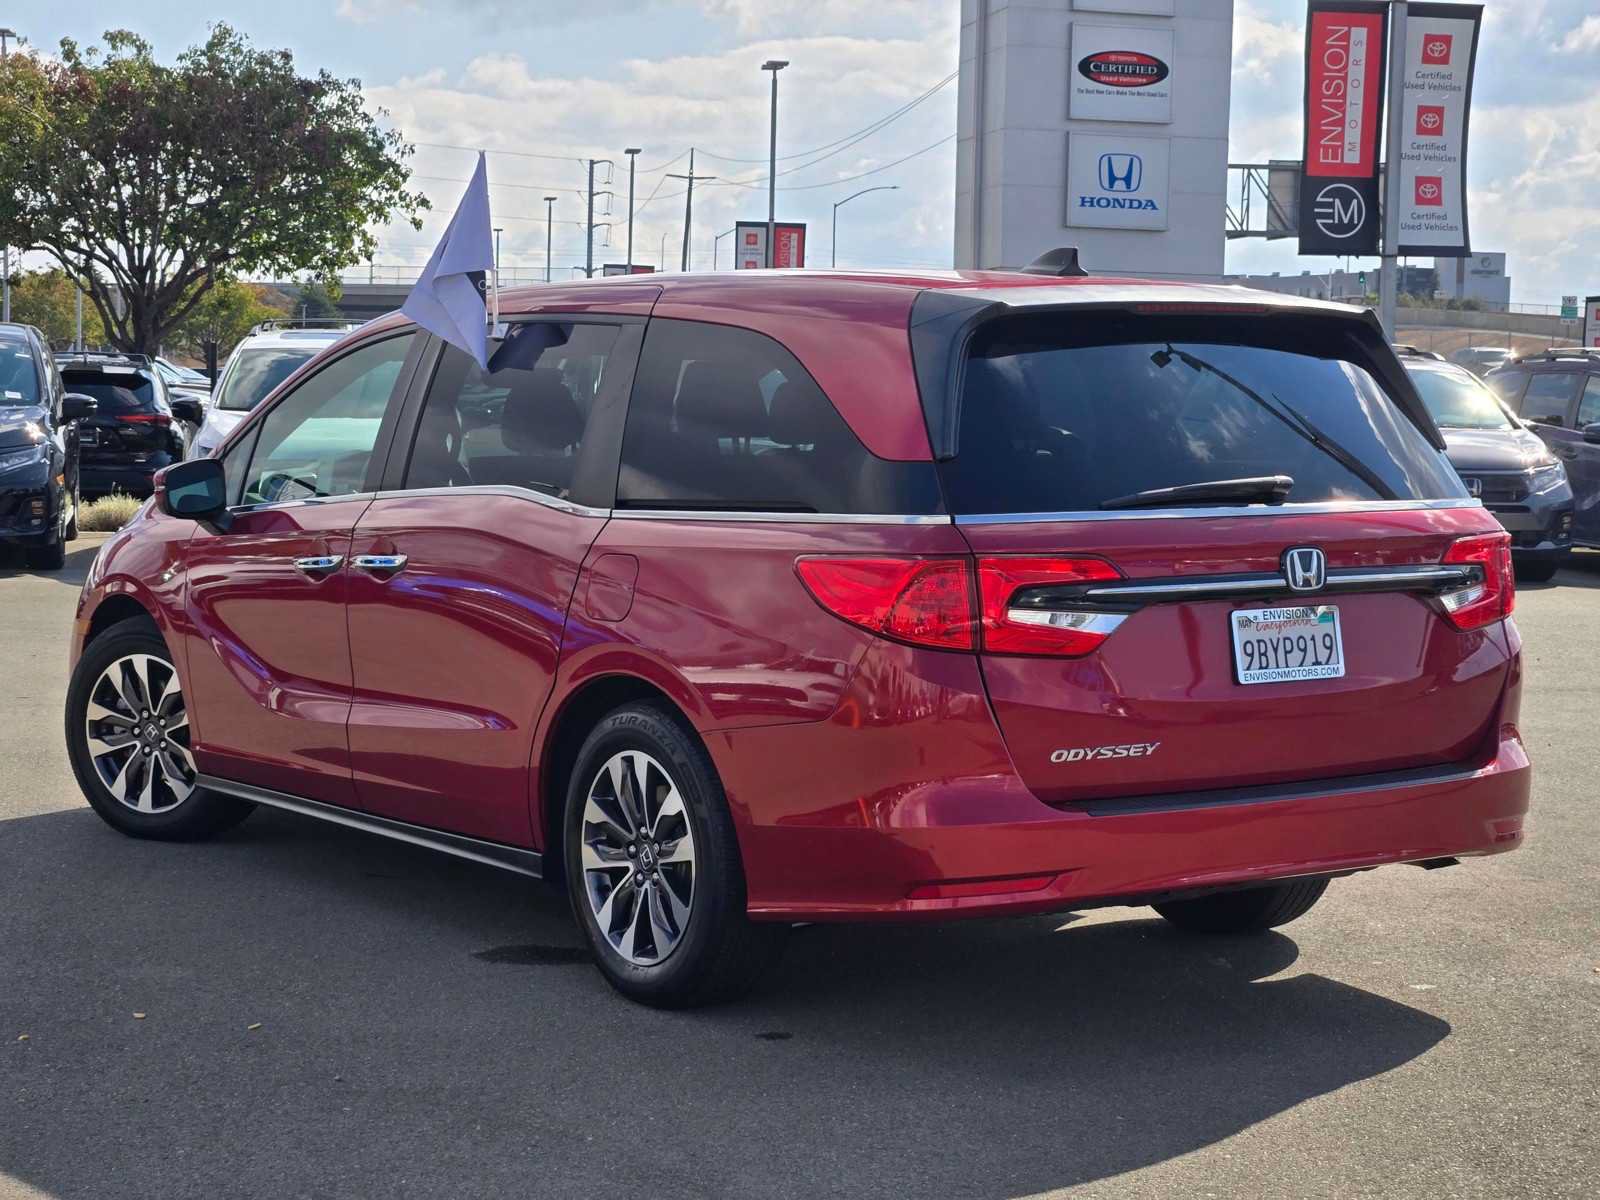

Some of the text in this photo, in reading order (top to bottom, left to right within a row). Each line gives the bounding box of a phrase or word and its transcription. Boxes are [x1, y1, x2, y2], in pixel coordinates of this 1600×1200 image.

[1090, 62, 1158, 75] CERTIFIED
[1415, 70, 1453, 81] Certified
[1404, 81, 1462, 92] Used Vehicles
[1319, 25, 1349, 164] ENVISION
[1347, 39, 1364, 153] MOTORS
[1410, 142, 1447, 152] Certified
[1400, 152, 1457, 163] Used Vehicles
[1079, 196, 1159, 211] HONDA
[1410, 212, 1448, 221] Certified
[1400, 222, 1459, 232] Used Vehicles
[1263, 609, 1310, 620] ENVISION
[1242, 632, 1334, 671] 9BYP919
[1243, 667, 1340, 682] ENVISIONMOTORS.COM
[1050, 742, 1161, 763] ODYSSEY
